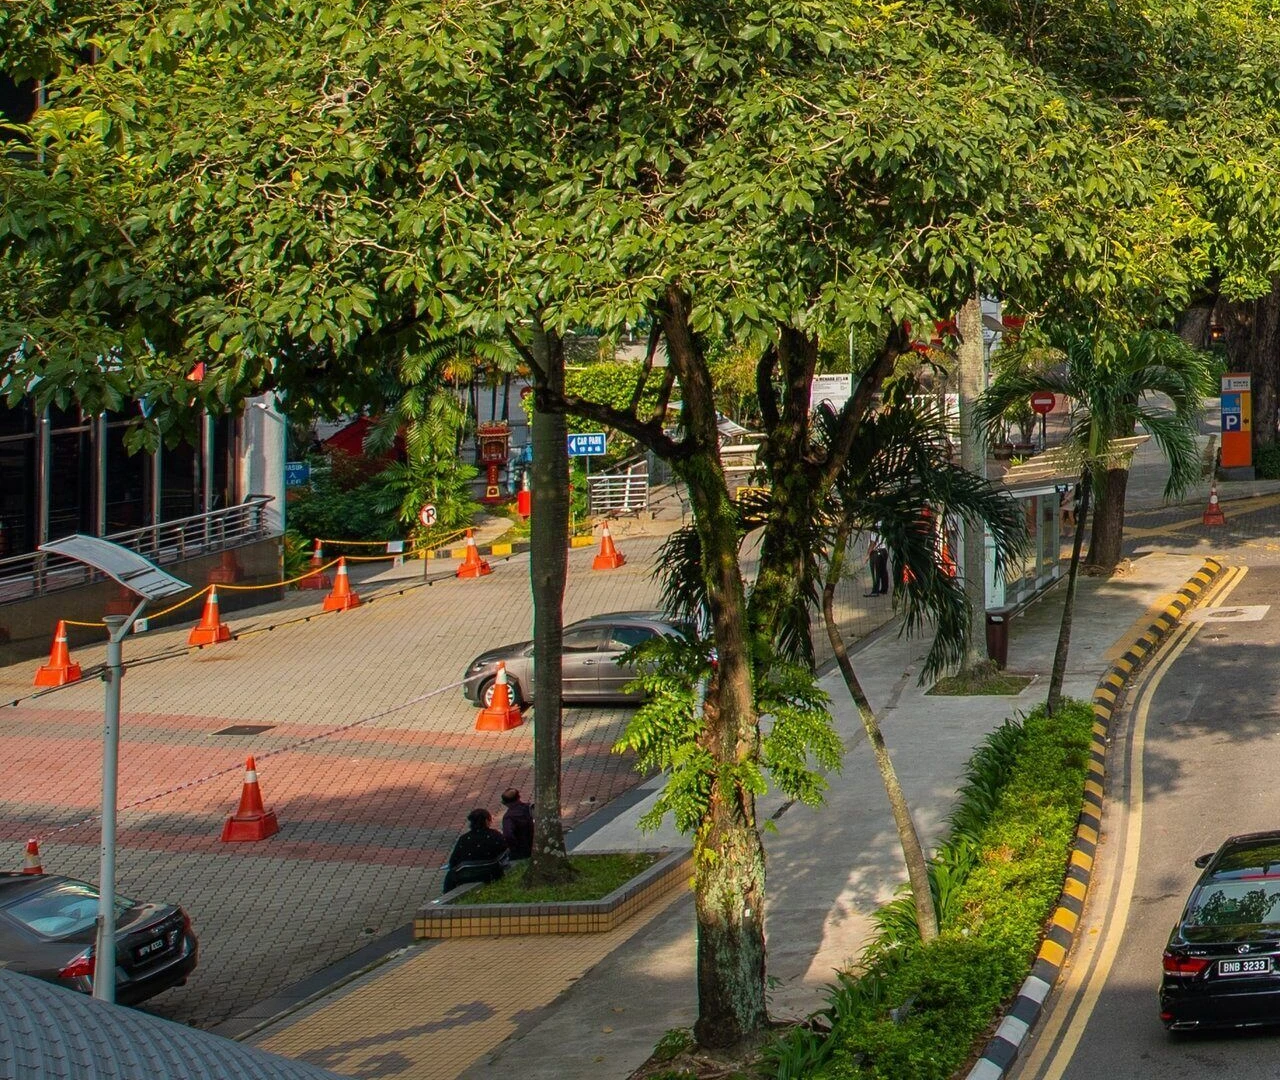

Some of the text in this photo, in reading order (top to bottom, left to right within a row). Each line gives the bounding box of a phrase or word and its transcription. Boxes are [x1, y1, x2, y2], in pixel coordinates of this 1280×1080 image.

[1226, 415, 1238, 430] P
[577, 436, 602, 446] CAR PARK
[1223, 961, 1265, 972] BNB 3233
